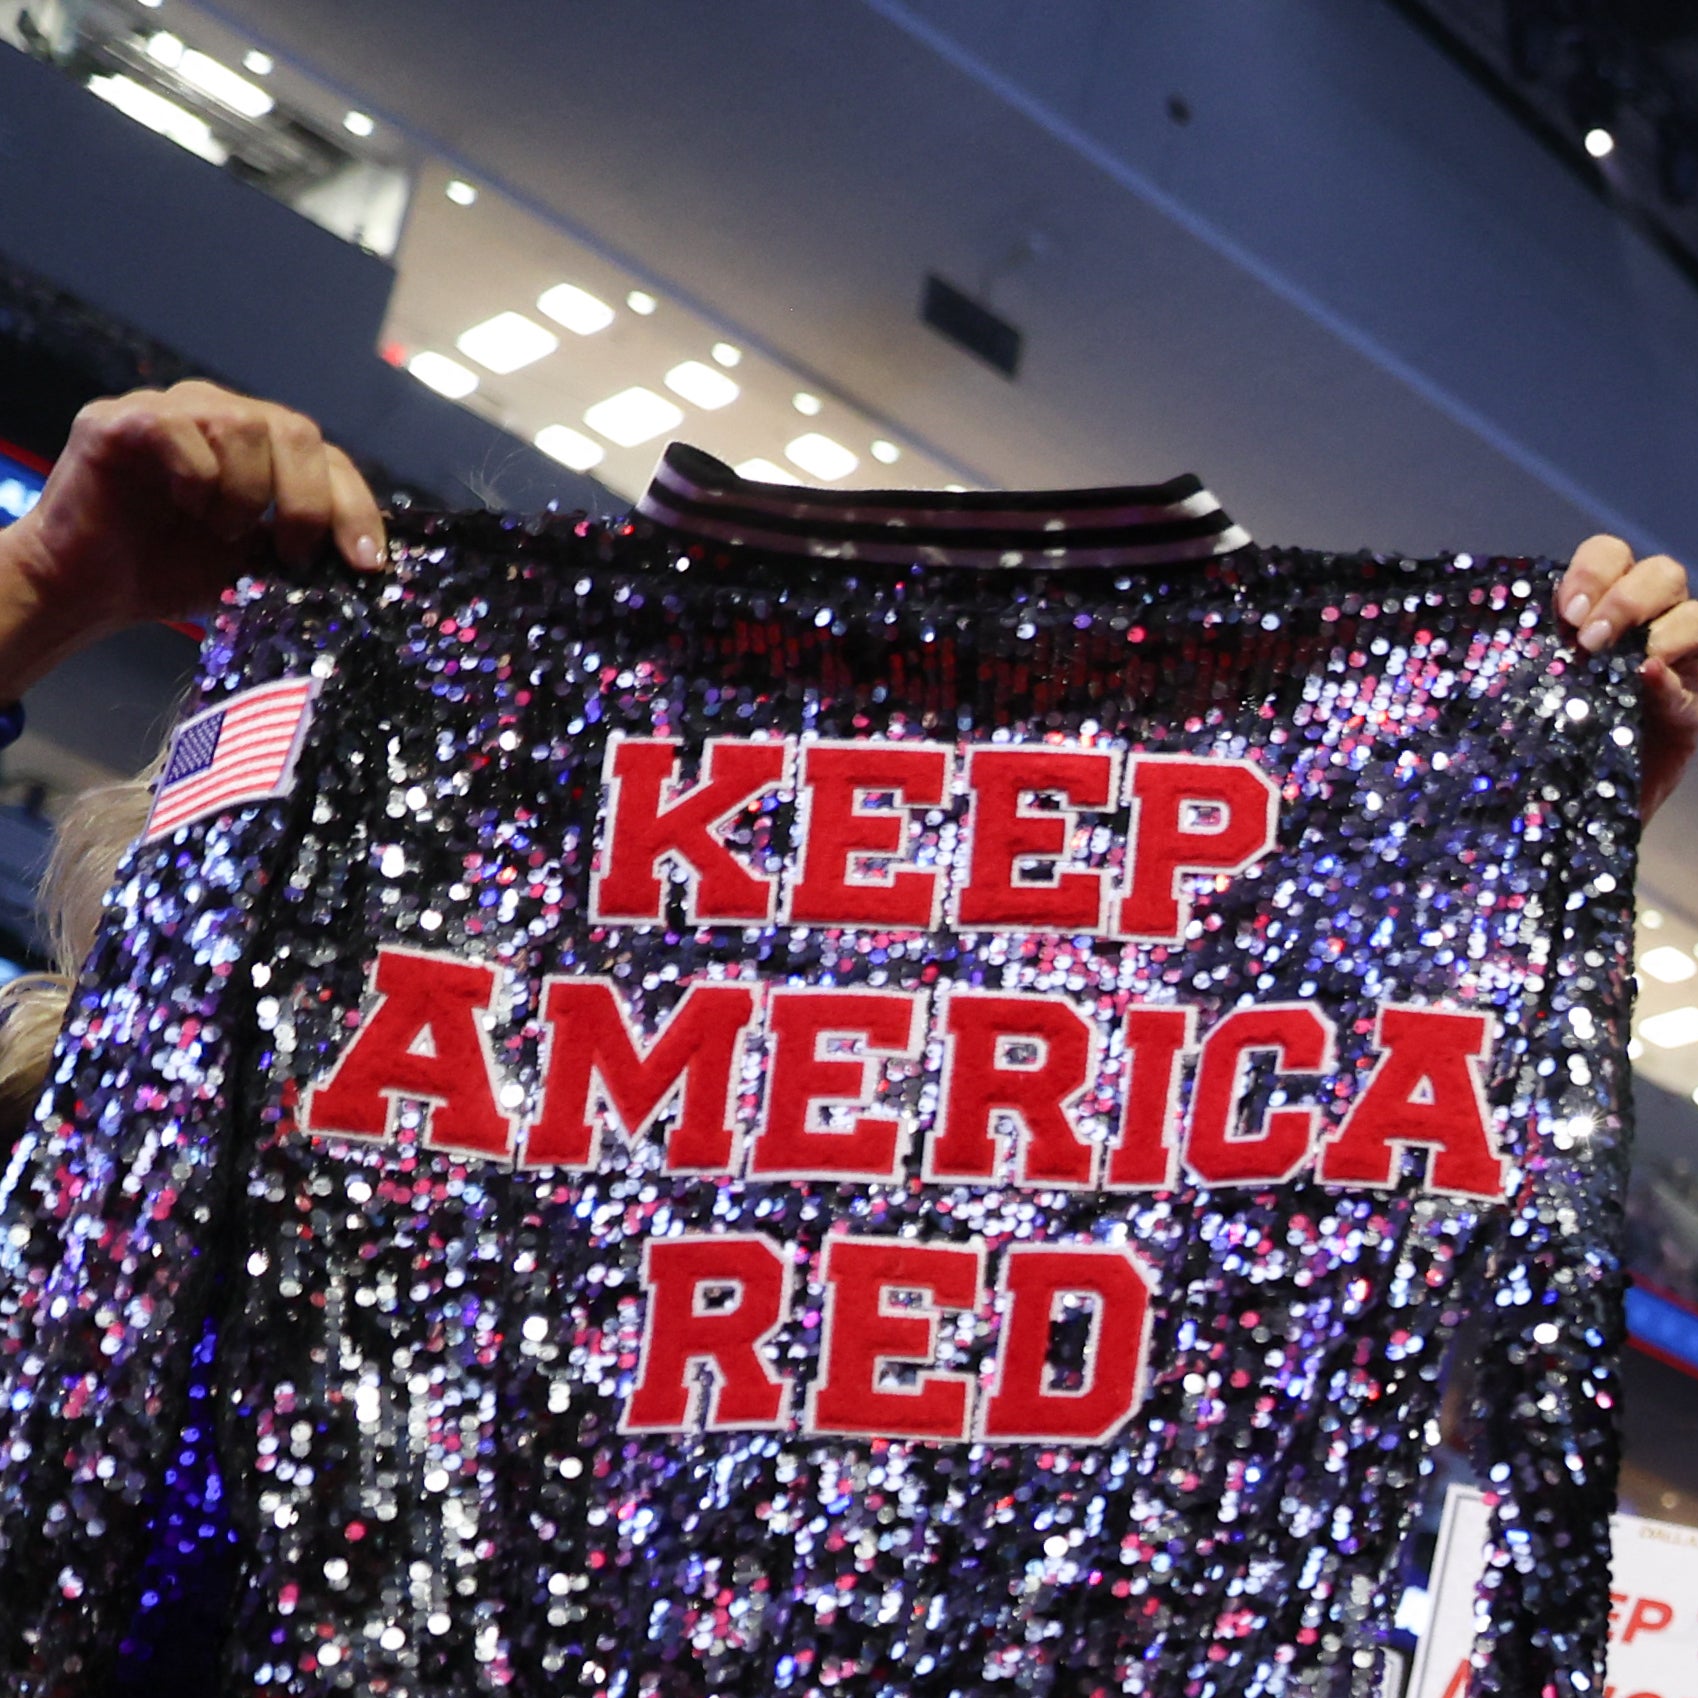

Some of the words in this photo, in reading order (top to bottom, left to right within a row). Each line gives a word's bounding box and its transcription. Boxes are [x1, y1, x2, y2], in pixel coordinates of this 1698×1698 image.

[588, 732, 1281, 945] KEEP
[303, 944, 1506, 1202] AMERICA
[619, 1231, 1161, 1443] RED
